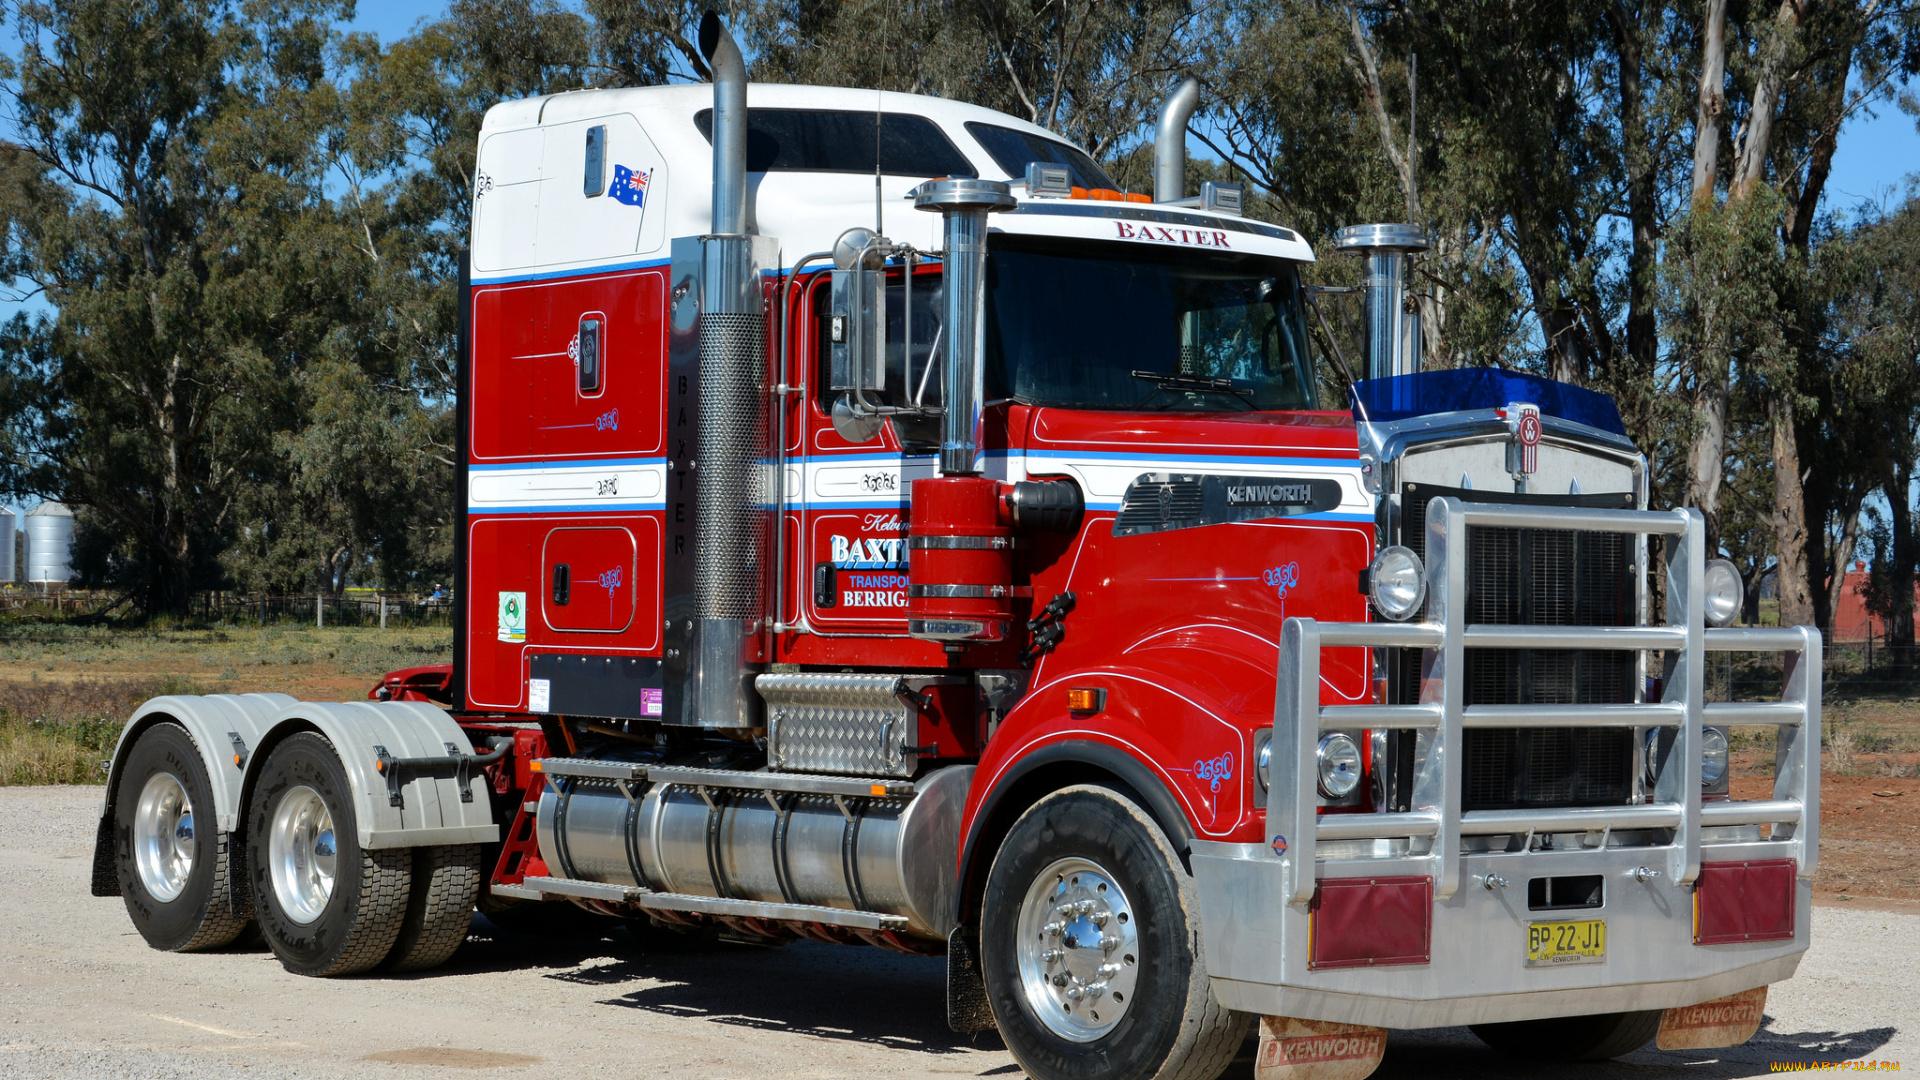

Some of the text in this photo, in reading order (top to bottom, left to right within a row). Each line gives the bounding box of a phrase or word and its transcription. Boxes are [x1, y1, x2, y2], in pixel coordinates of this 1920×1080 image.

[1114, 221, 1231, 248] BAXTER
[675, 375, 688, 554] BAXTER
[1227, 485, 1312, 502] KENWORTH
[861, 513, 909, 531] Kelvin
[843, 591, 909, 607] BERRIG
[1683, 1006, 1759, 1025] KENWORTH
[1284, 1036, 1380, 1061] KENWORTH
